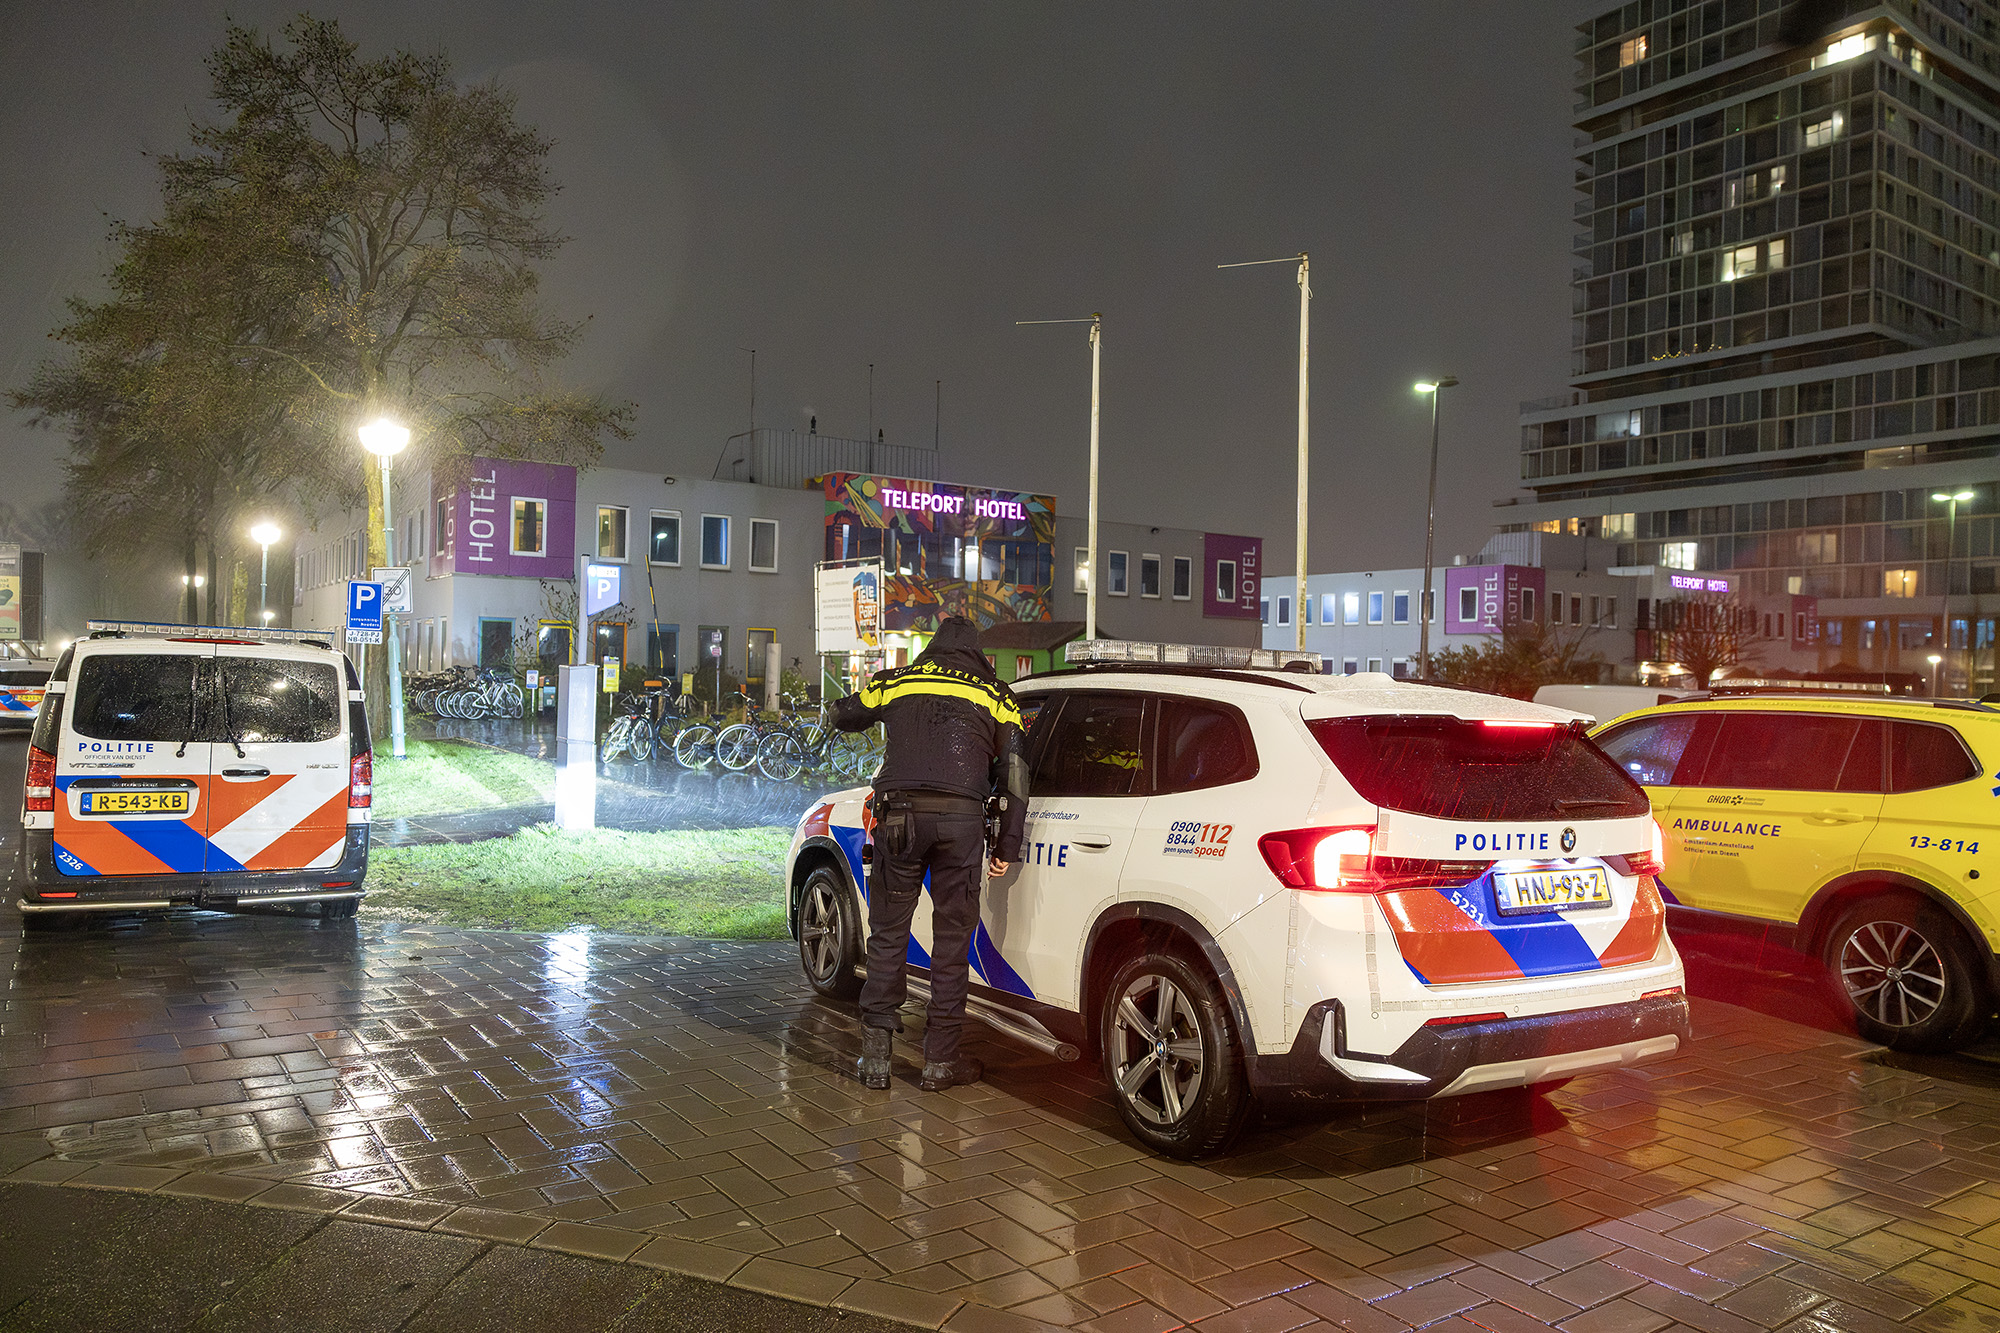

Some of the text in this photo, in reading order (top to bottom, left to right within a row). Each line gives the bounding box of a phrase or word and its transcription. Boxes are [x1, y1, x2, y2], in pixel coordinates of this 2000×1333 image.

[881, 489, 1026, 520] TELEPORT HOTEL
[469, 470, 496, 562] HOTEL
[1242, 546, 1255, 610] HOTEL
[1671, 575, 1729, 593] TELEPORT HOTEL
[356, 585, 376, 610] P
[597, 578, 611, 600] P
[1484, 572, 1498, 628] HOTEL
[912, 661, 980, 684] POLITIE
[78, 742, 155, 753] POLITIE
[99, 795, 182, 809] R-543-KB
[1707, 795, 1731, 804] GHOR
[1171, 821, 1233, 844] 0900 112
[1673, 818, 1782, 837] AMBULANCE
[1166, 833, 1196, 846] 8844
[1455, 833, 1549, 851] POLITIE
[1910, 835, 1980, 855] 13-814
[58, 851, 84, 871] 2326
[1194, 846, 1226, 857] spoed
[1514, 873, 1603, 902] HNJ-93-Z
[1450, 890, 1485, 927] 5231
